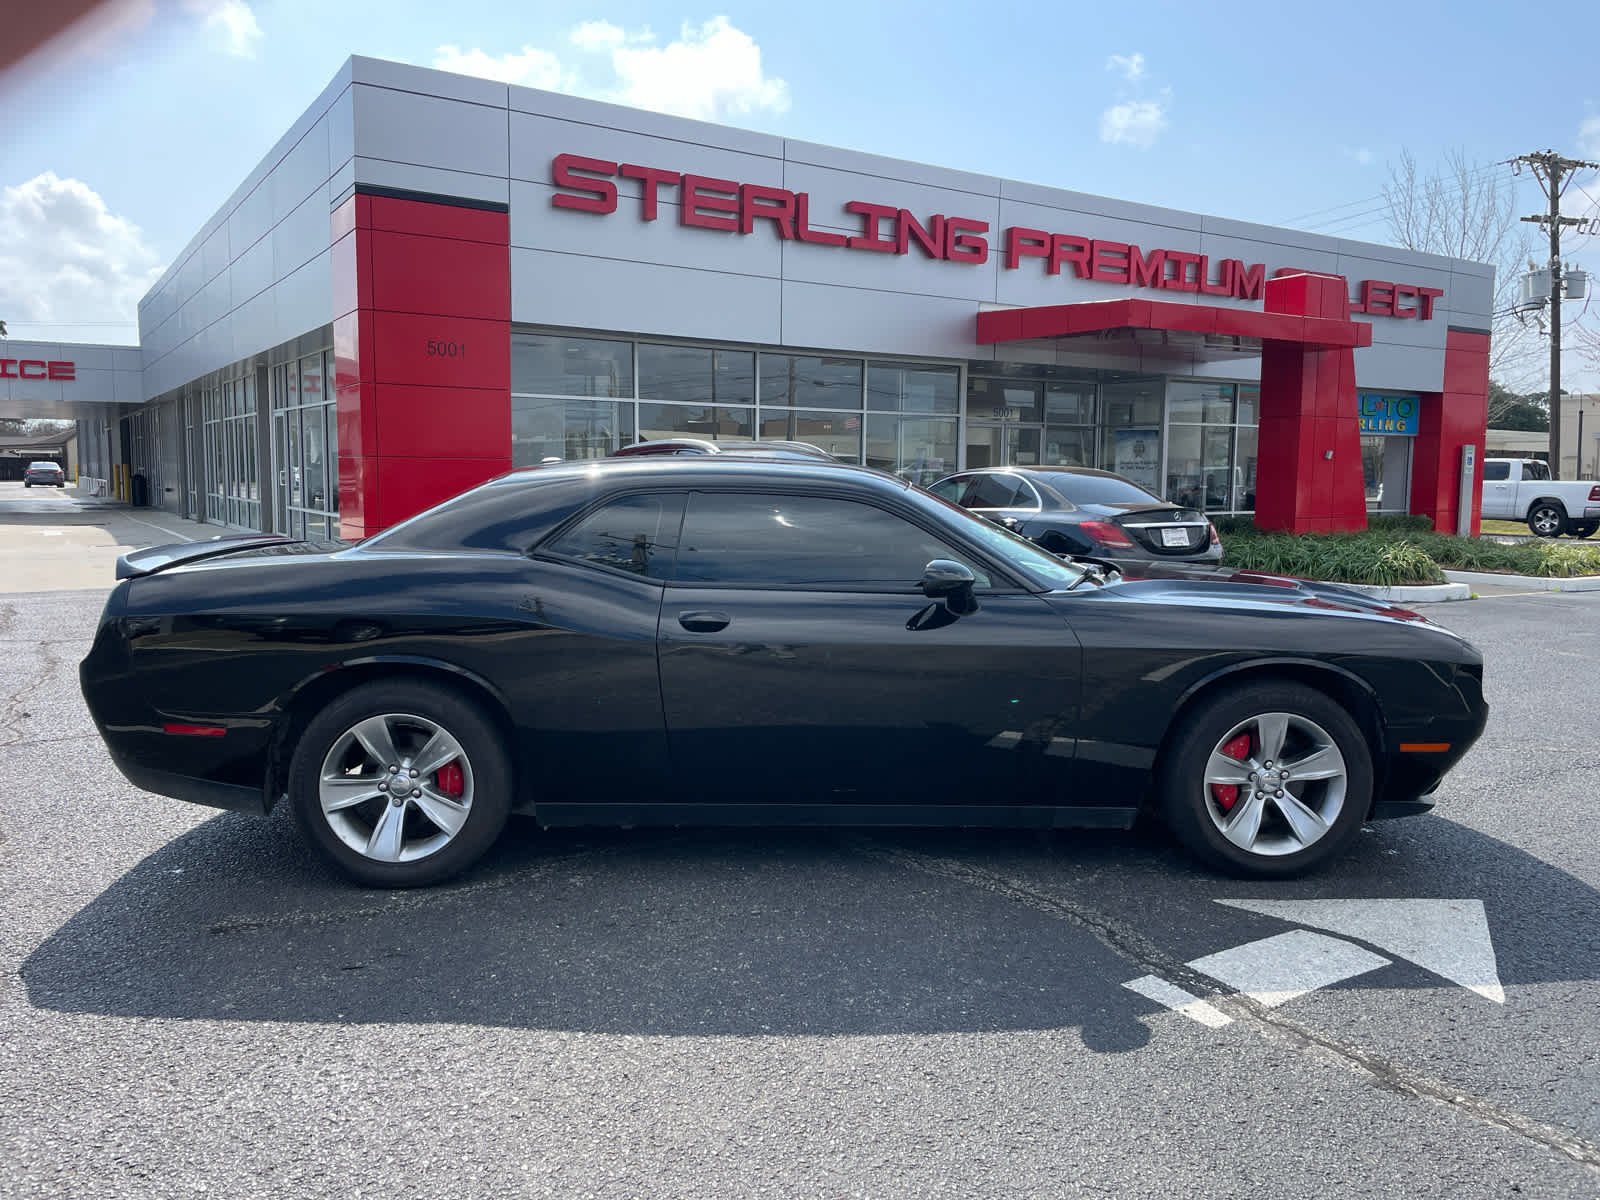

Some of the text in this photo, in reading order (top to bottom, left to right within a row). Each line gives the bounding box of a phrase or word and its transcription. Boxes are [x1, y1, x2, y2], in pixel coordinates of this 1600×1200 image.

[552, 153, 989, 264] STERLING
[1005, 227, 1265, 299] PREMIUM
[426, 340, 465, 360] 5001
